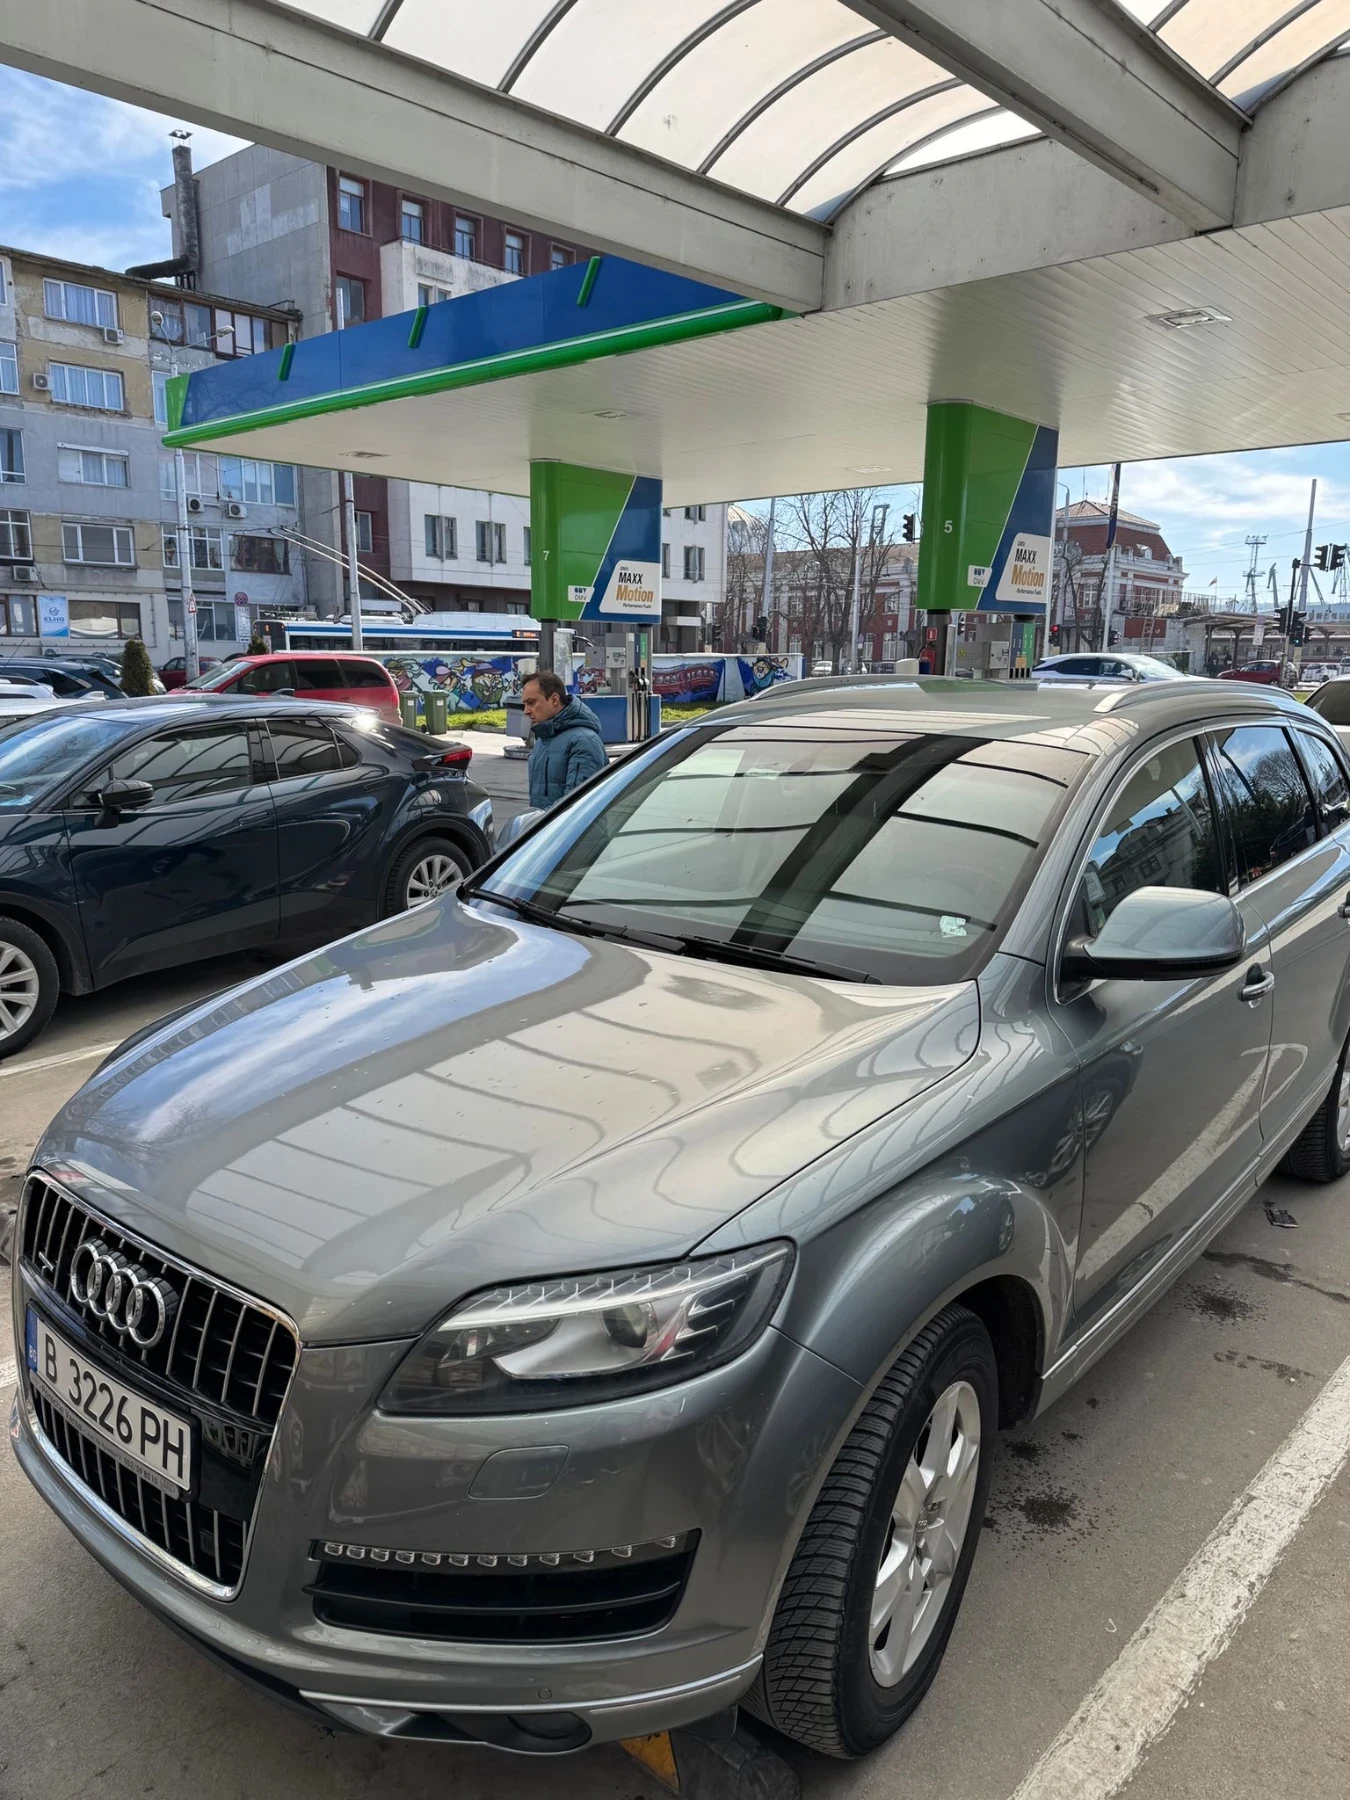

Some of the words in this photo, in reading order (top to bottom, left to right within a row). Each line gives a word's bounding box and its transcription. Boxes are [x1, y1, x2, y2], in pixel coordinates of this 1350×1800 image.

[944, 520, 953, 533] 5
[543, 550, 550, 561] 7
[1015, 548, 1037, 564] MAXX
[618, 572, 643, 584] MAXX
[1011, 564, 1045, 587] Motion
[616, 584, 654, 602] Motion
[29, 1344, 37, 1362] BG
[46, 1333, 57, 1384] B
[69, 1357, 133, 1444] 3226
[141, 1406, 184, 1479] PH
